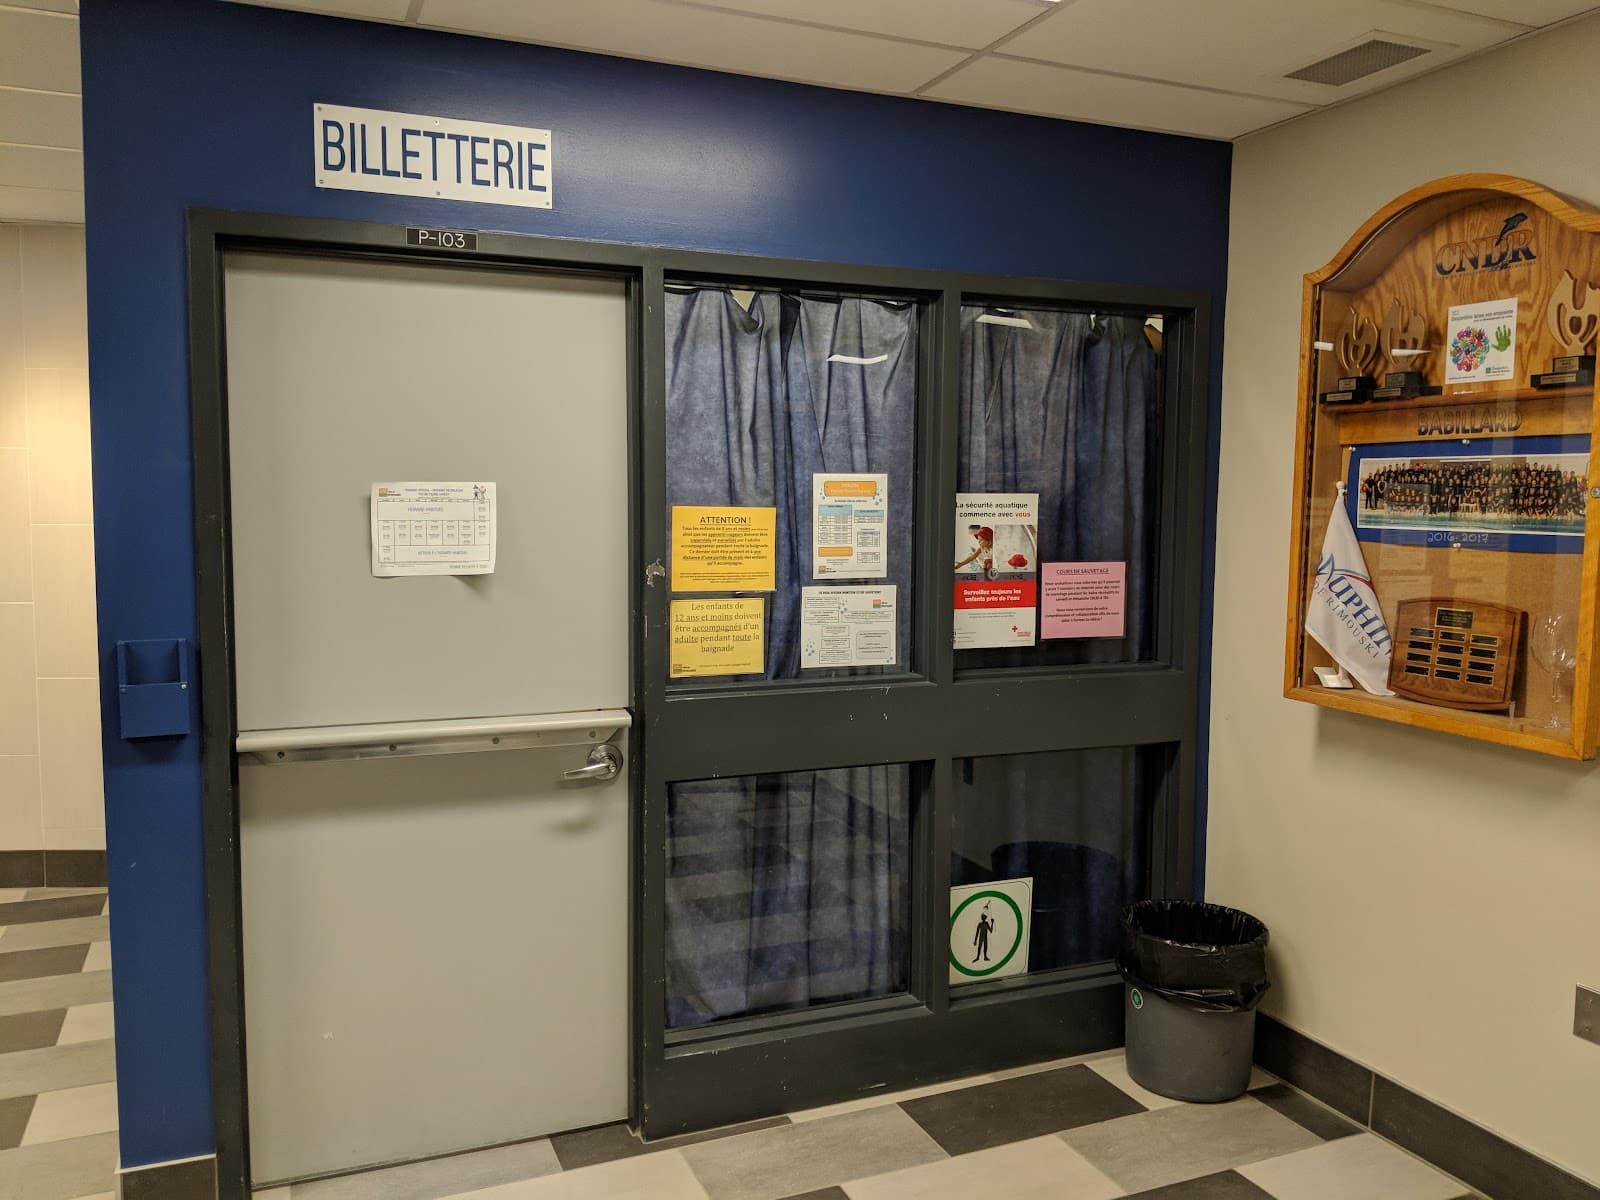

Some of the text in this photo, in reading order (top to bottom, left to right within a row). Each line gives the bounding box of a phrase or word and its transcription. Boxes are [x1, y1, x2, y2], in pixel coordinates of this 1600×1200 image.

[322, 119, 547, 192] BILLETTERIE
[418, 230, 465, 248] P-103
[1418, 407, 1522, 436] BABILLARD
[995, 502, 1028, 510] aquatique
[675, 614, 684, 622] 12
[1326, 597, 1380, 658] RIMOUSKI
[675, 635, 698, 643] adulte
[700, 634, 731, 644] pendant
[701, 644, 734, 654] baignade
